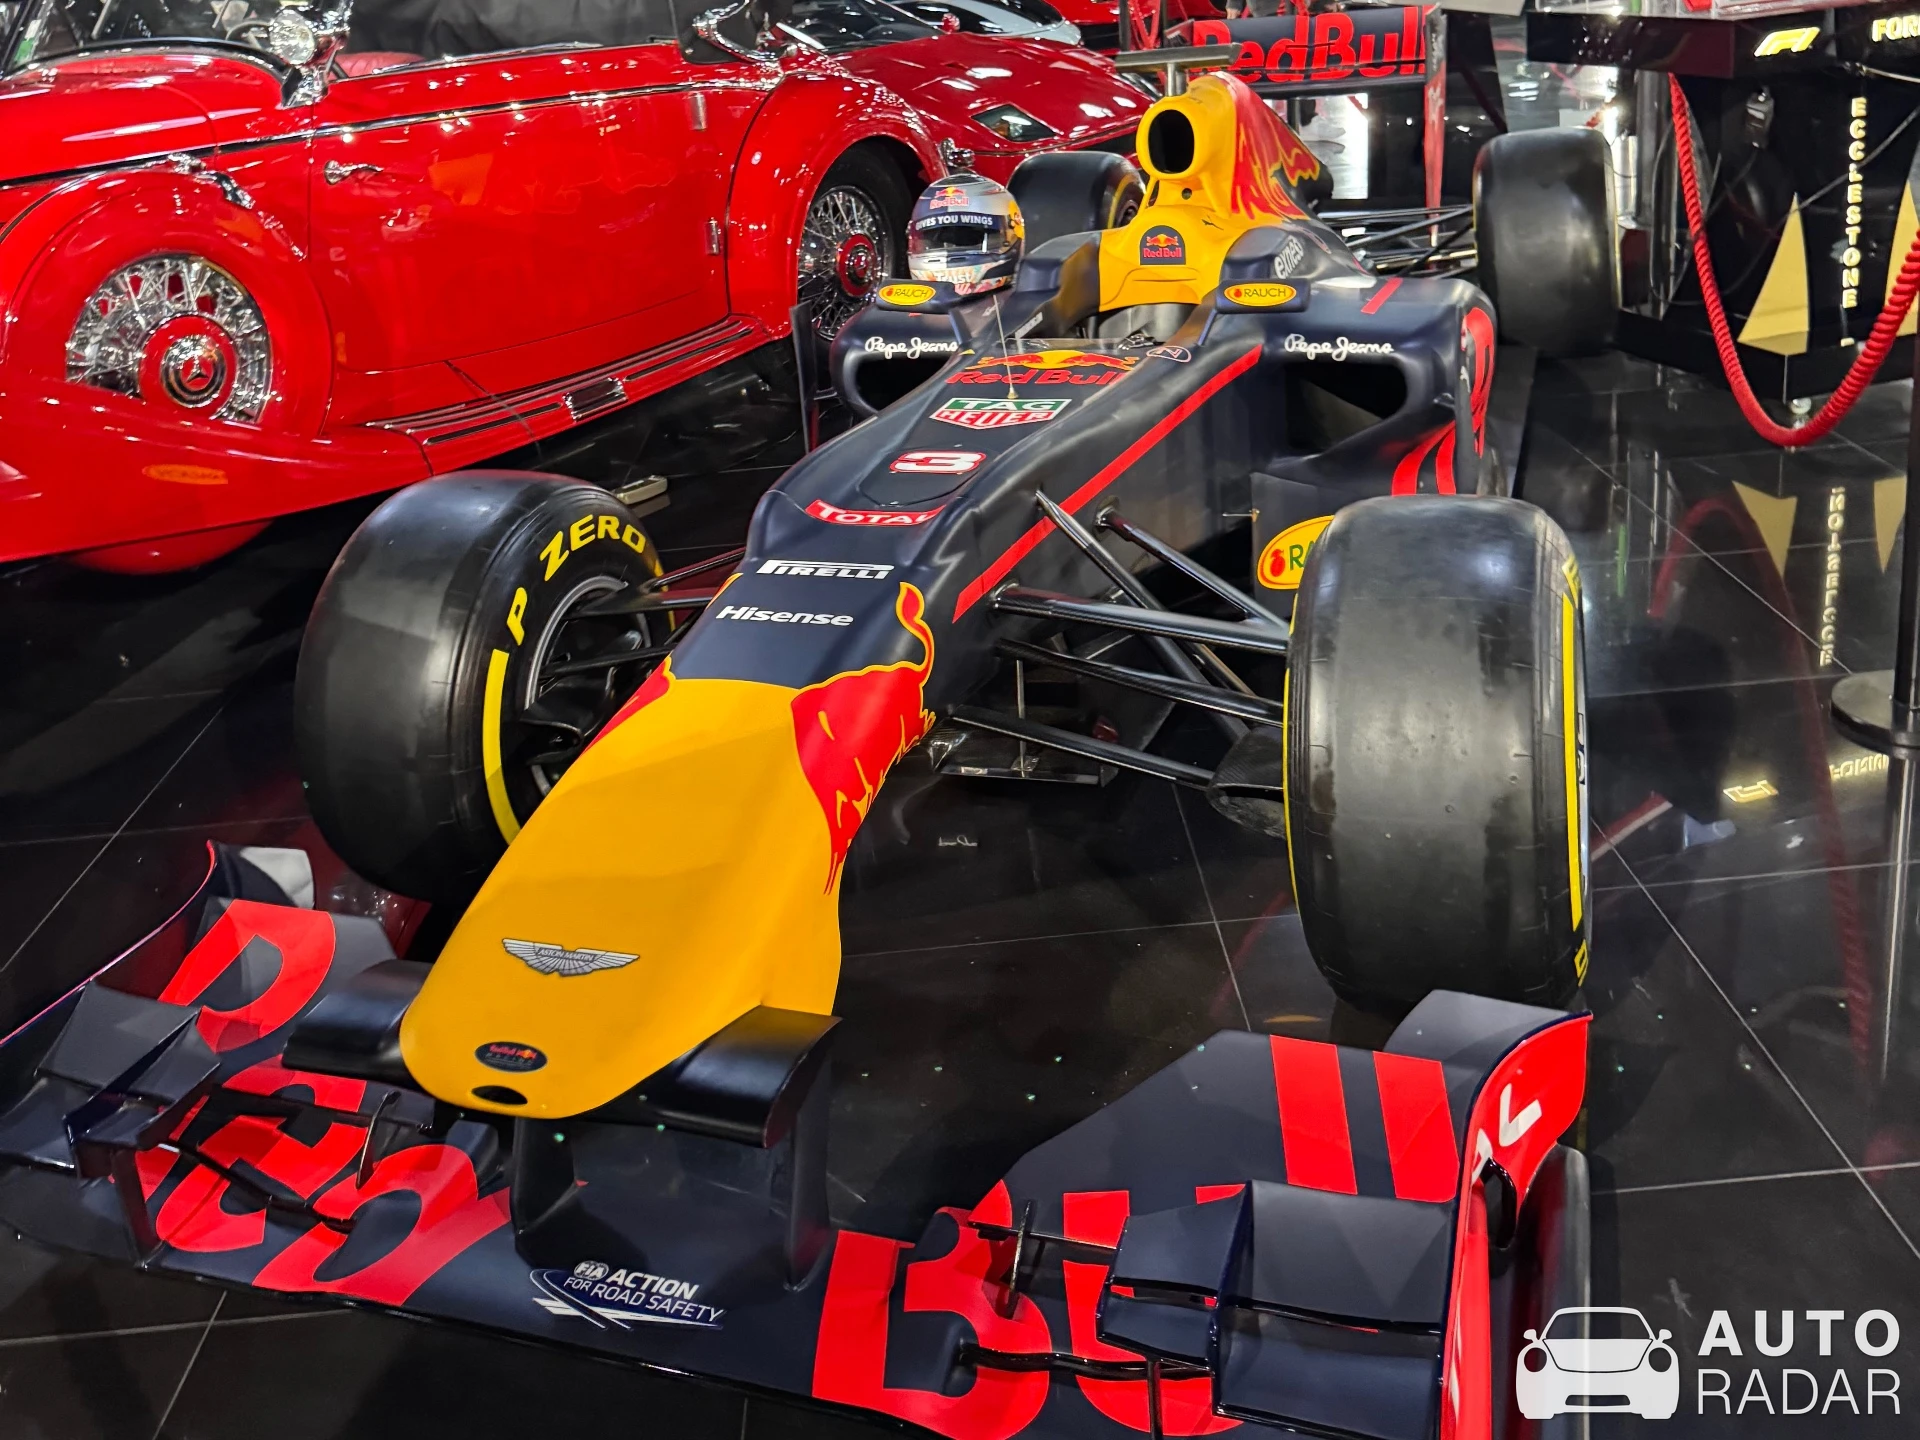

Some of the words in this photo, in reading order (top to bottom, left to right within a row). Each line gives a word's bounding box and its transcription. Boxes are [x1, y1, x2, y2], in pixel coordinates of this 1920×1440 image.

[1842, 97, 1867, 309] ECCLESTONE
[937, 215, 959, 224] YOU
[960, 215, 993, 225] WINGS
[894, 288, 929, 298] RAUCH
[1243, 287, 1287, 298] RAUCH
[864, 336, 908, 359] Pepe
[906, 337, 958, 359] Jeans
[1284, 333, 1333, 361] Pepe
[1332, 336, 1395, 361] Jeans
[957, 400, 1057, 411] TAG
[940, 410, 1053, 426] HEUER
[890, 450, 987, 474] 3
[816, 502, 933, 524] TOTAL
[506, 587, 528, 646] P
[540, 514, 647, 582] ZERO
[756, 559, 895, 580] PIRELLI
[715, 605, 854, 626] Hisense
[537, 949, 564, 958] ASTON
[564, 952, 594, 961] MARTIN
[575, 1262, 605, 1279] FIA
[606, 1269, 699, 1300] ACTION
[563, 1277, 593, 1291] FOR
[590, 1283, 646, 1306] ROAD
[646, 1295, 726, 1322] SAFETY
